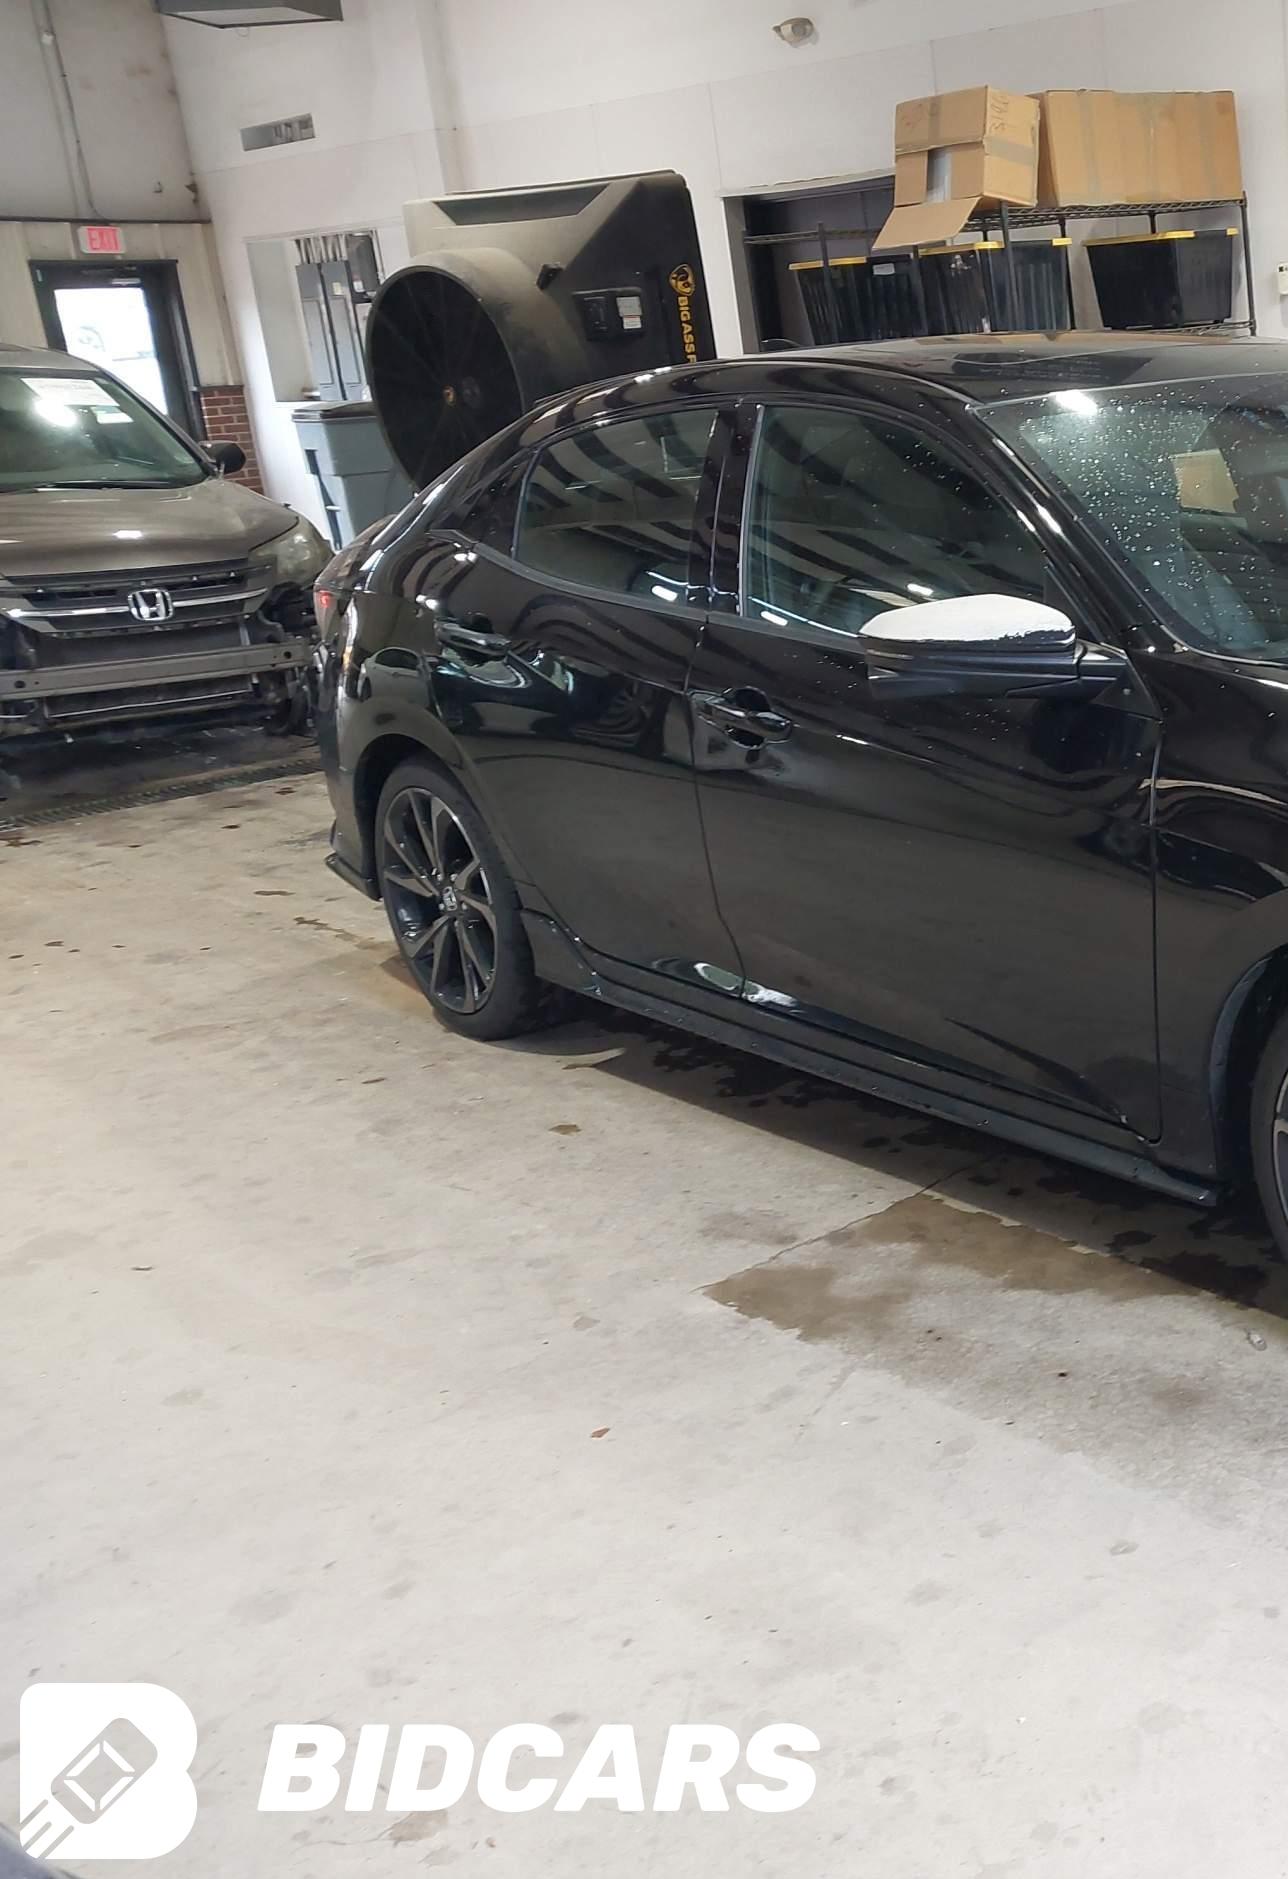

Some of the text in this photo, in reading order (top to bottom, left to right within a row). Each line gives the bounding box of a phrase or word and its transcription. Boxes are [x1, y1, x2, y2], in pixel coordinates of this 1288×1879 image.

[88, 228, 119, 250] EXIT
[677, 296, 691, 321] BIG
[681, 323, 696, 353] ASS
